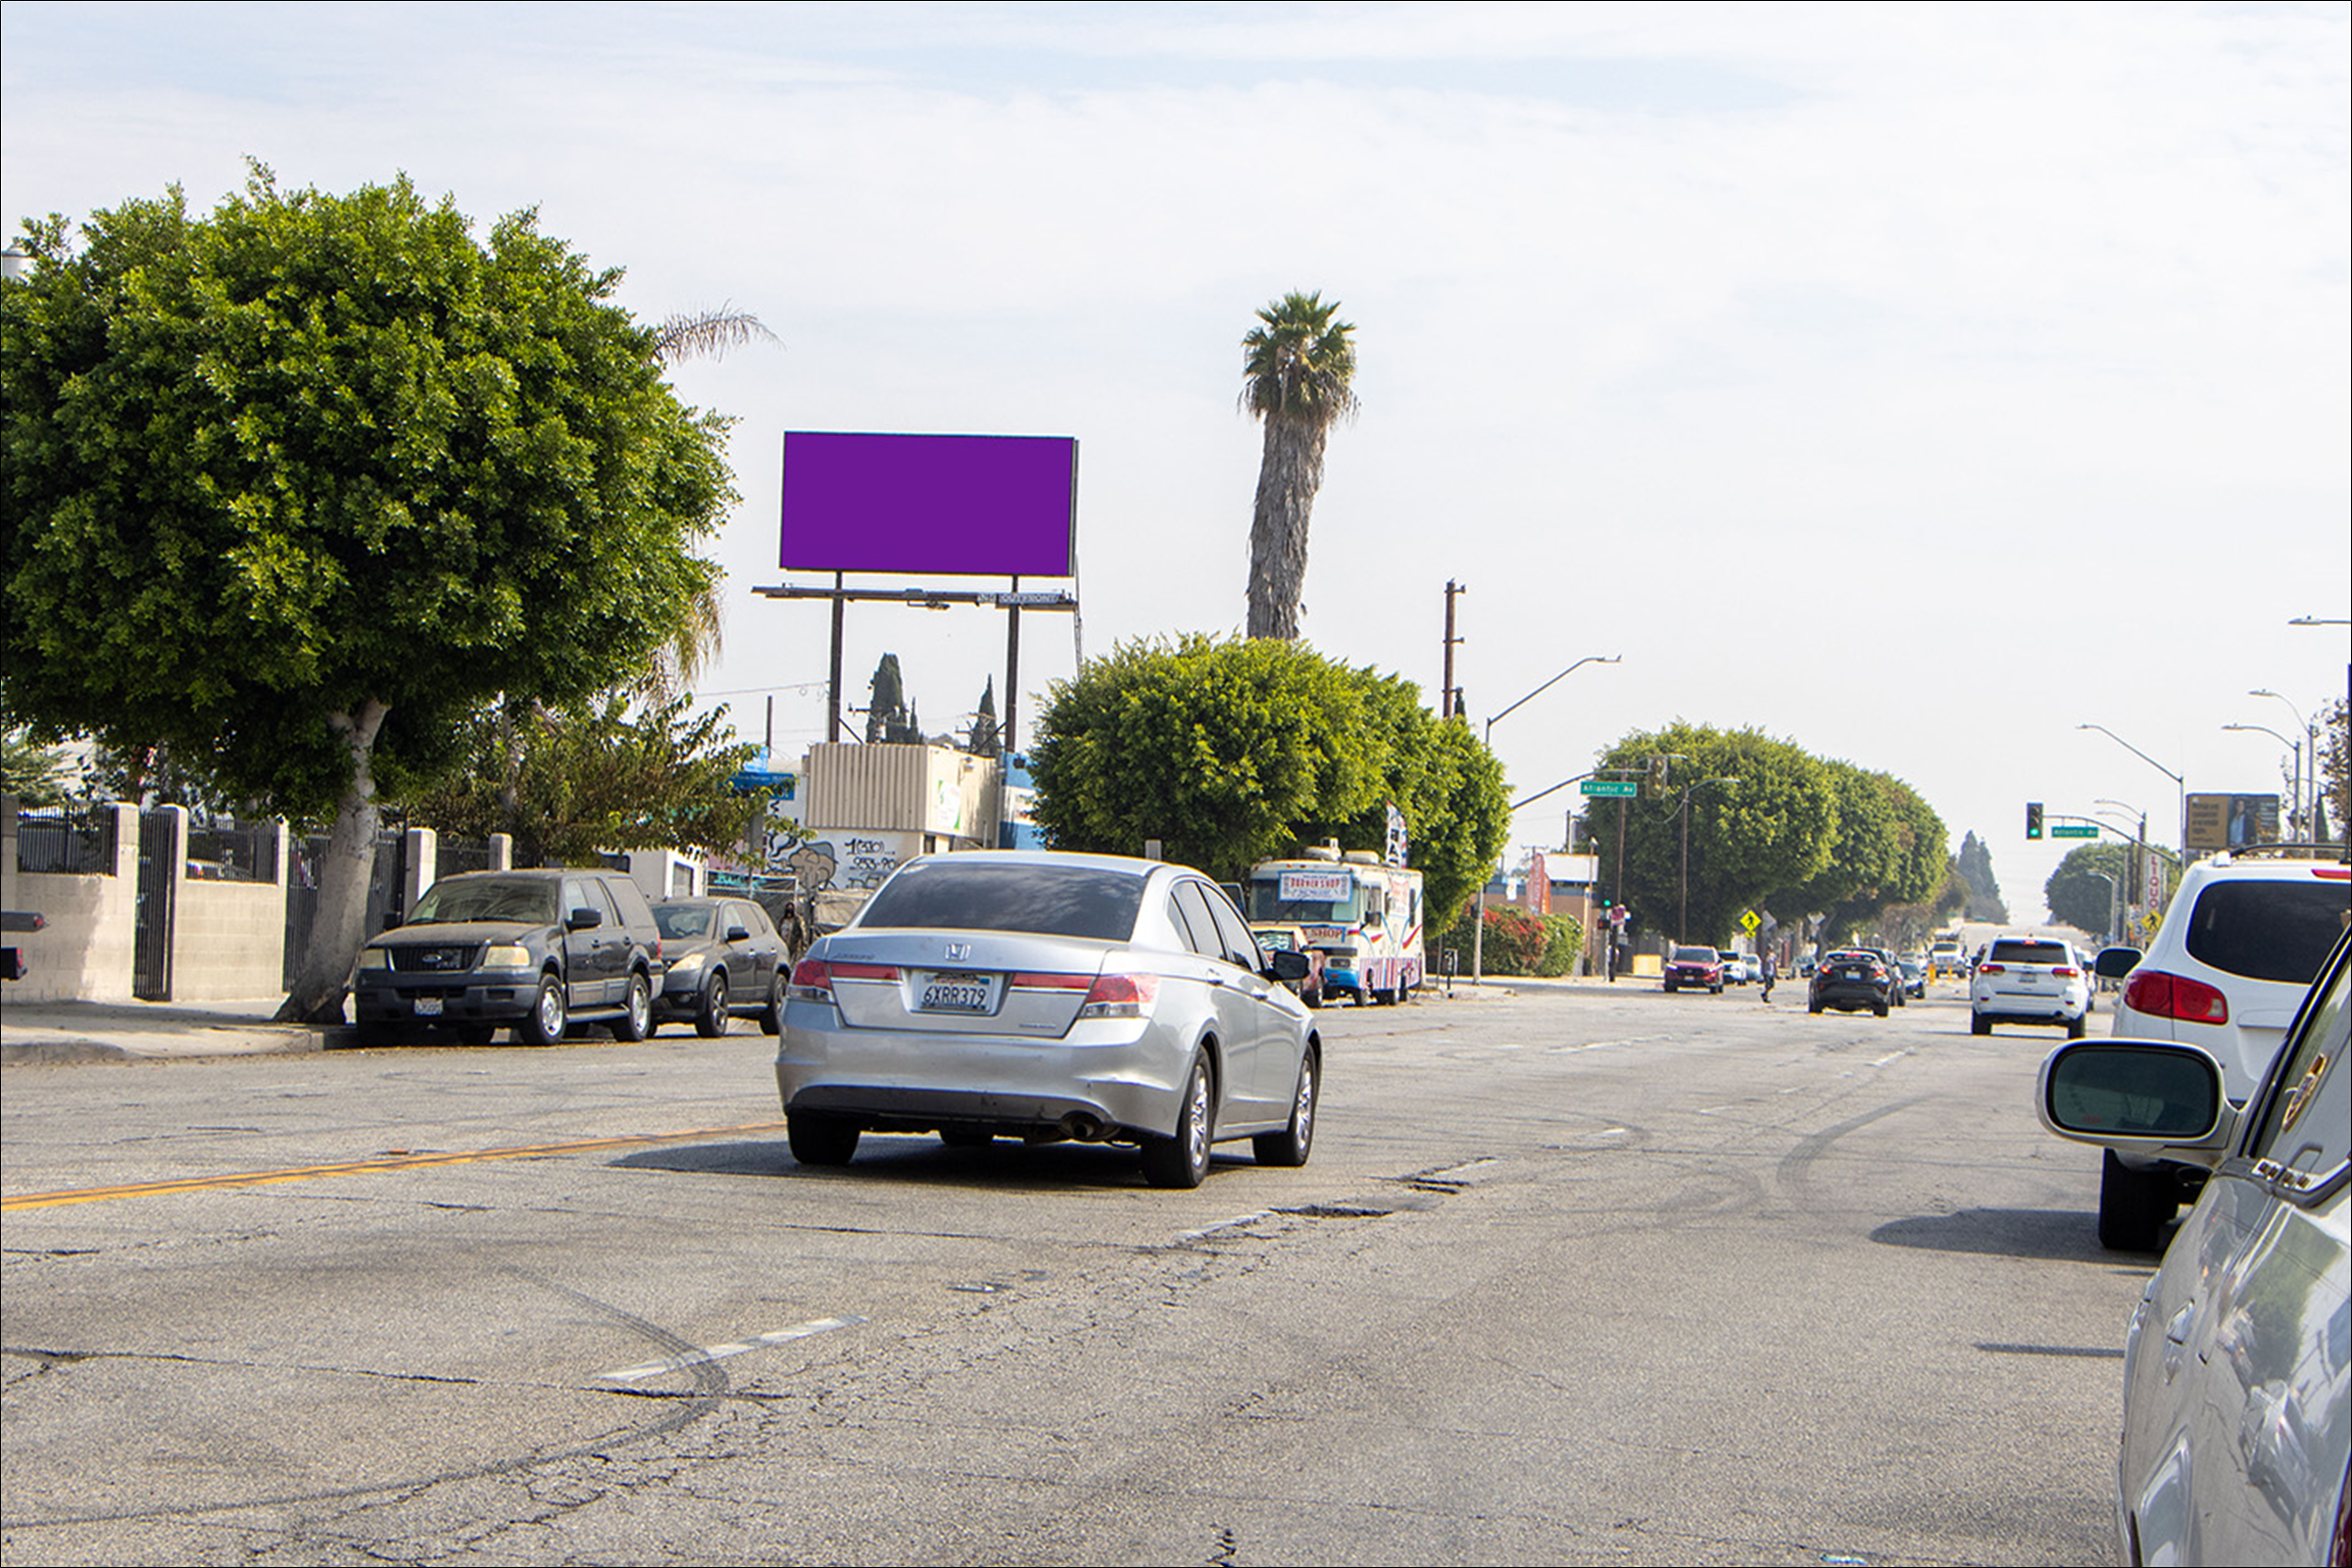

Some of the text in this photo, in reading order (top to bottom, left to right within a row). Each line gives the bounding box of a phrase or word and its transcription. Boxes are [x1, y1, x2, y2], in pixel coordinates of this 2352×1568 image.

[1291, 877, 1341, 888] BARBER SHOP
[2148, 856, 2159, 908] LIQUO
[923, 985, 987, 1005] 6XRR379
